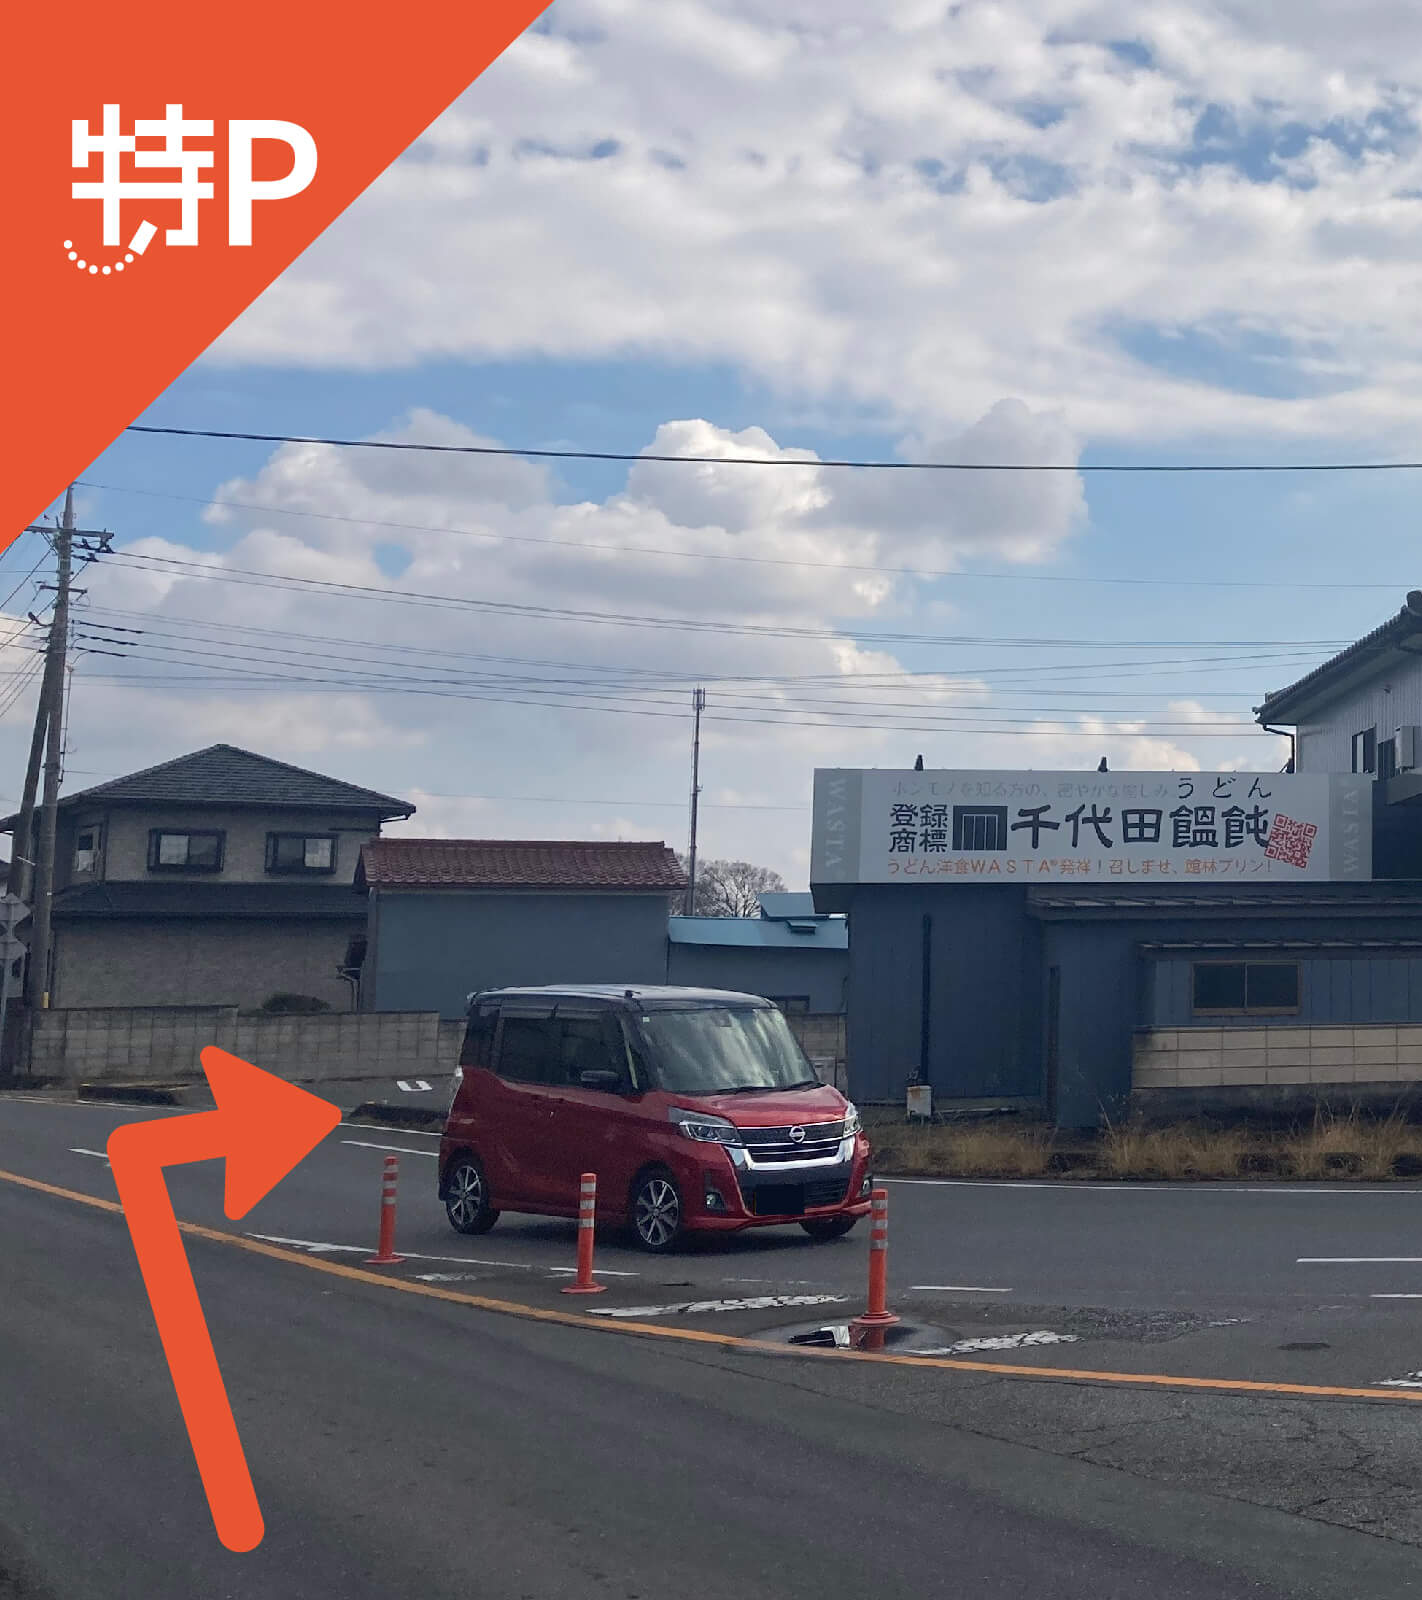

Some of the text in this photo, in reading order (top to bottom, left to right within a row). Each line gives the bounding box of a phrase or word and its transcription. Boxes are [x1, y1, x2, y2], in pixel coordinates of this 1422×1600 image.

[1177, 776, 1272, 799] うどん
[888, 803, 948, 828] 登録
[1010, 803, 1269, 849] 千代田饂飩
[888, 828, 948, 853] 商標
